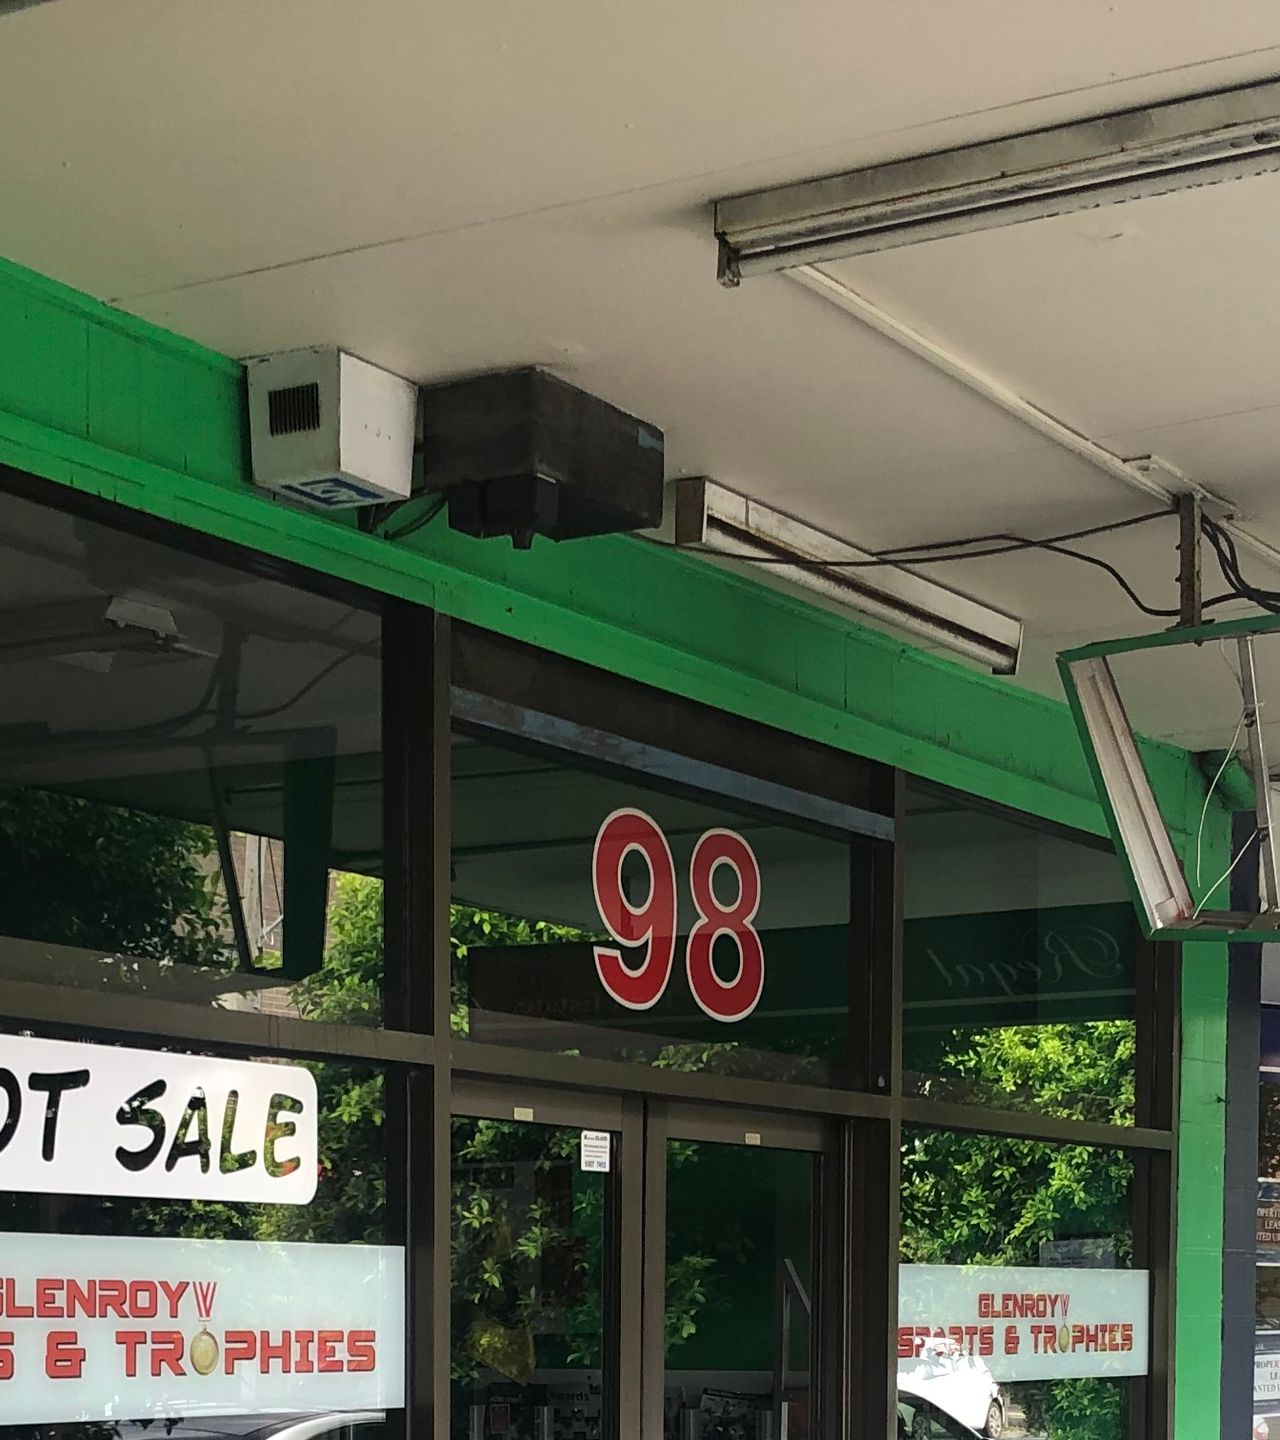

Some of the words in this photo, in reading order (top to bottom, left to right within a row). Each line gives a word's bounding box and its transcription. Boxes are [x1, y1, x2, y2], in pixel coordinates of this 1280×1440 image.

[592, 807, 765, 1023] 98
[115, 1079, 304, 1178] SALE
[978, 1293, 1059, 1319] GLENROY
[45, 1331, 86, 1379] &
[115, 1330, 376, 1378] TROPHIES
[1004, 1325, 1020, 1355] &
[1030, 1323, 1133, 1354] TROPHIES
